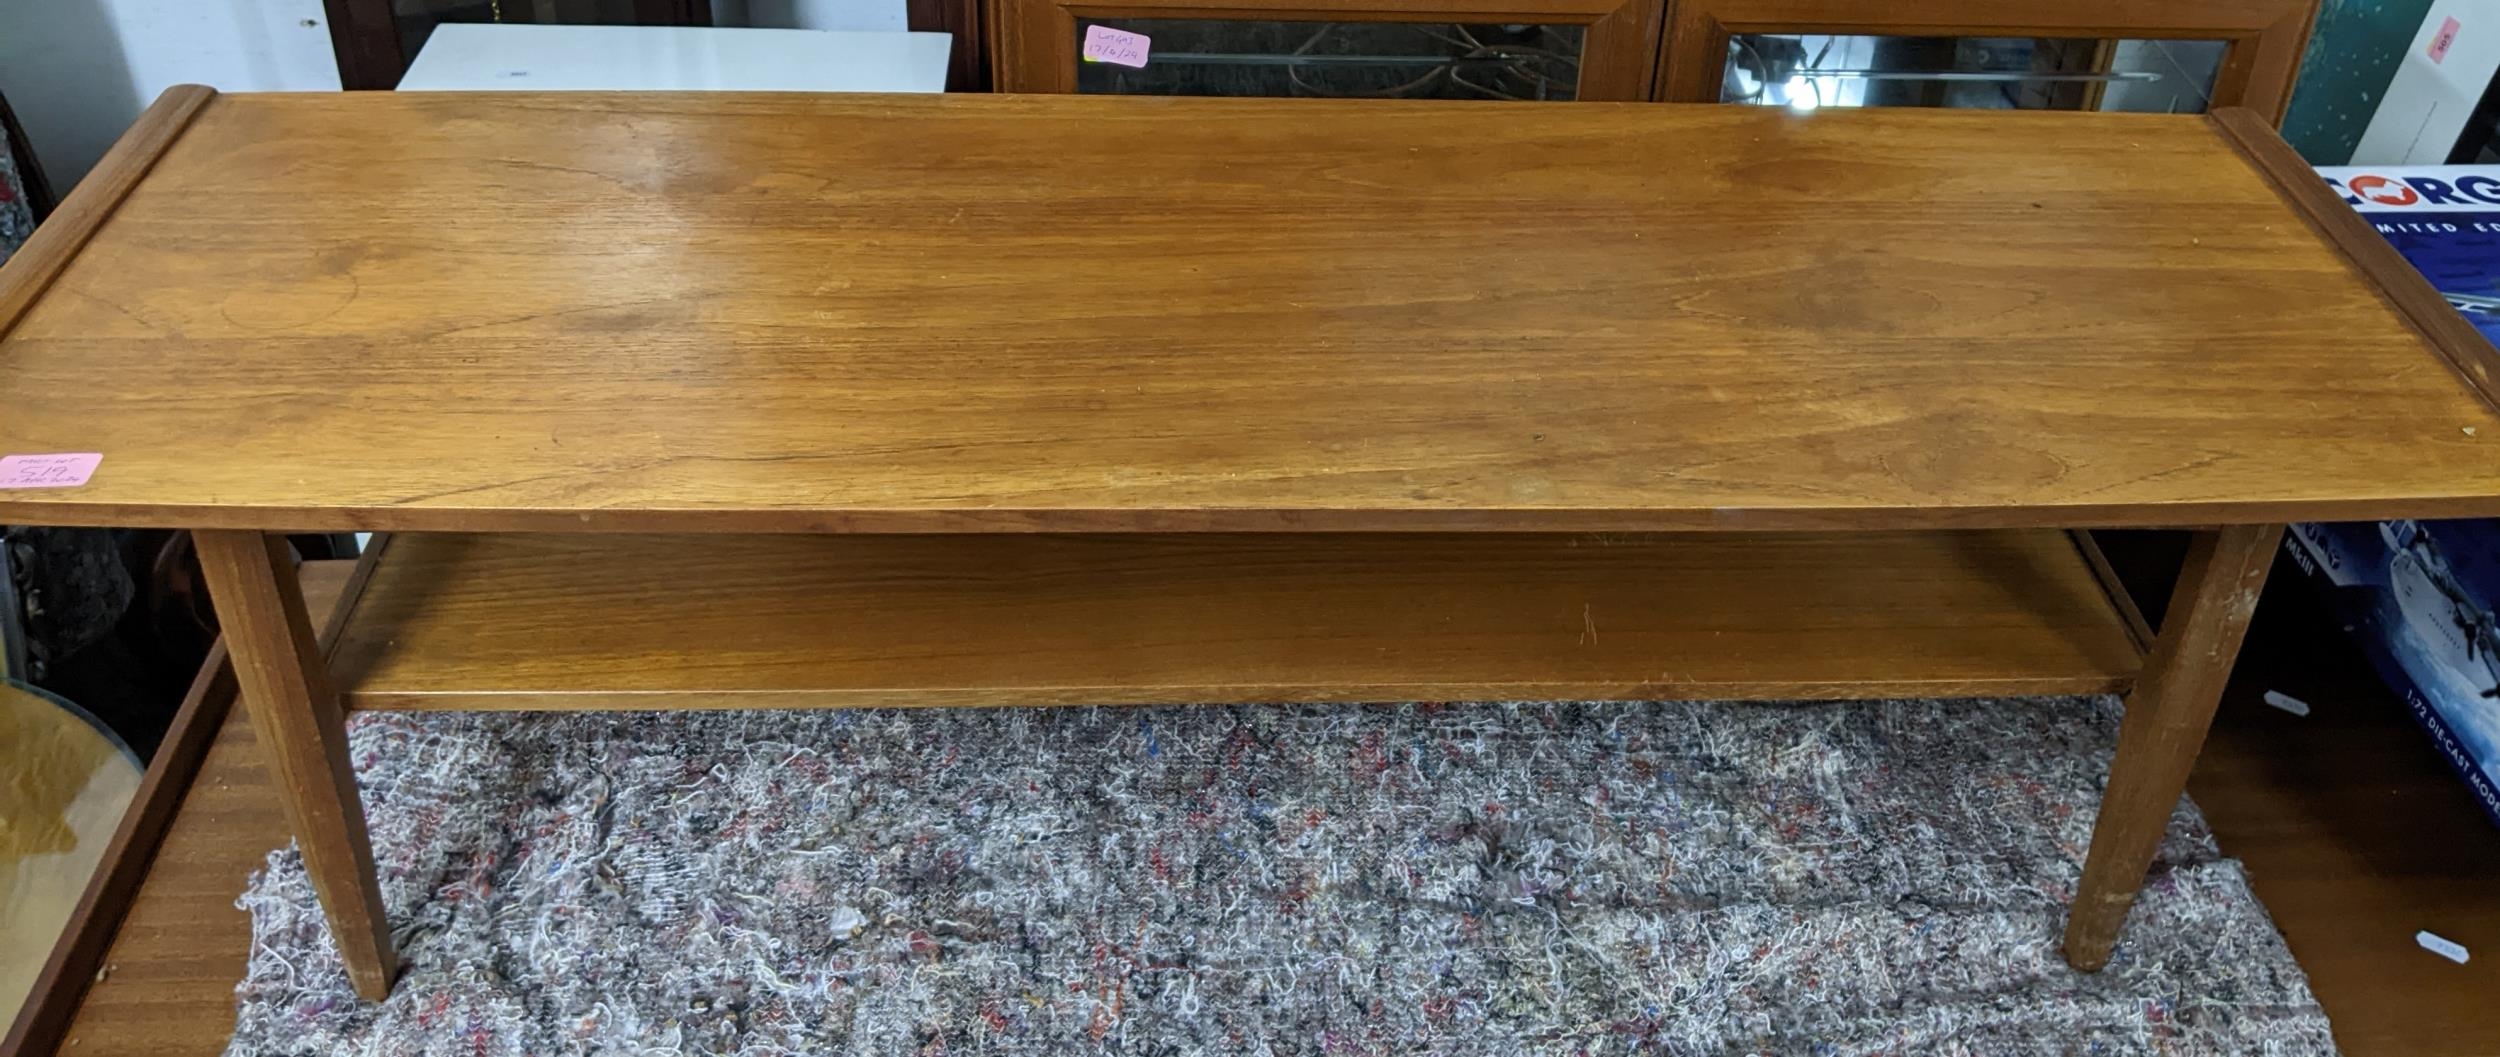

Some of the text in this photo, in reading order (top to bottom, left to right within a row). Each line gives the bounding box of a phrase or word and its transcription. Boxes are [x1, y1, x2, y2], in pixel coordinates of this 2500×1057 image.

[20, 466, 68, 477] 519
[2406, 689, 2428, 718] 1:72
[2428, 717, 2471, 773] DIE-CAST
